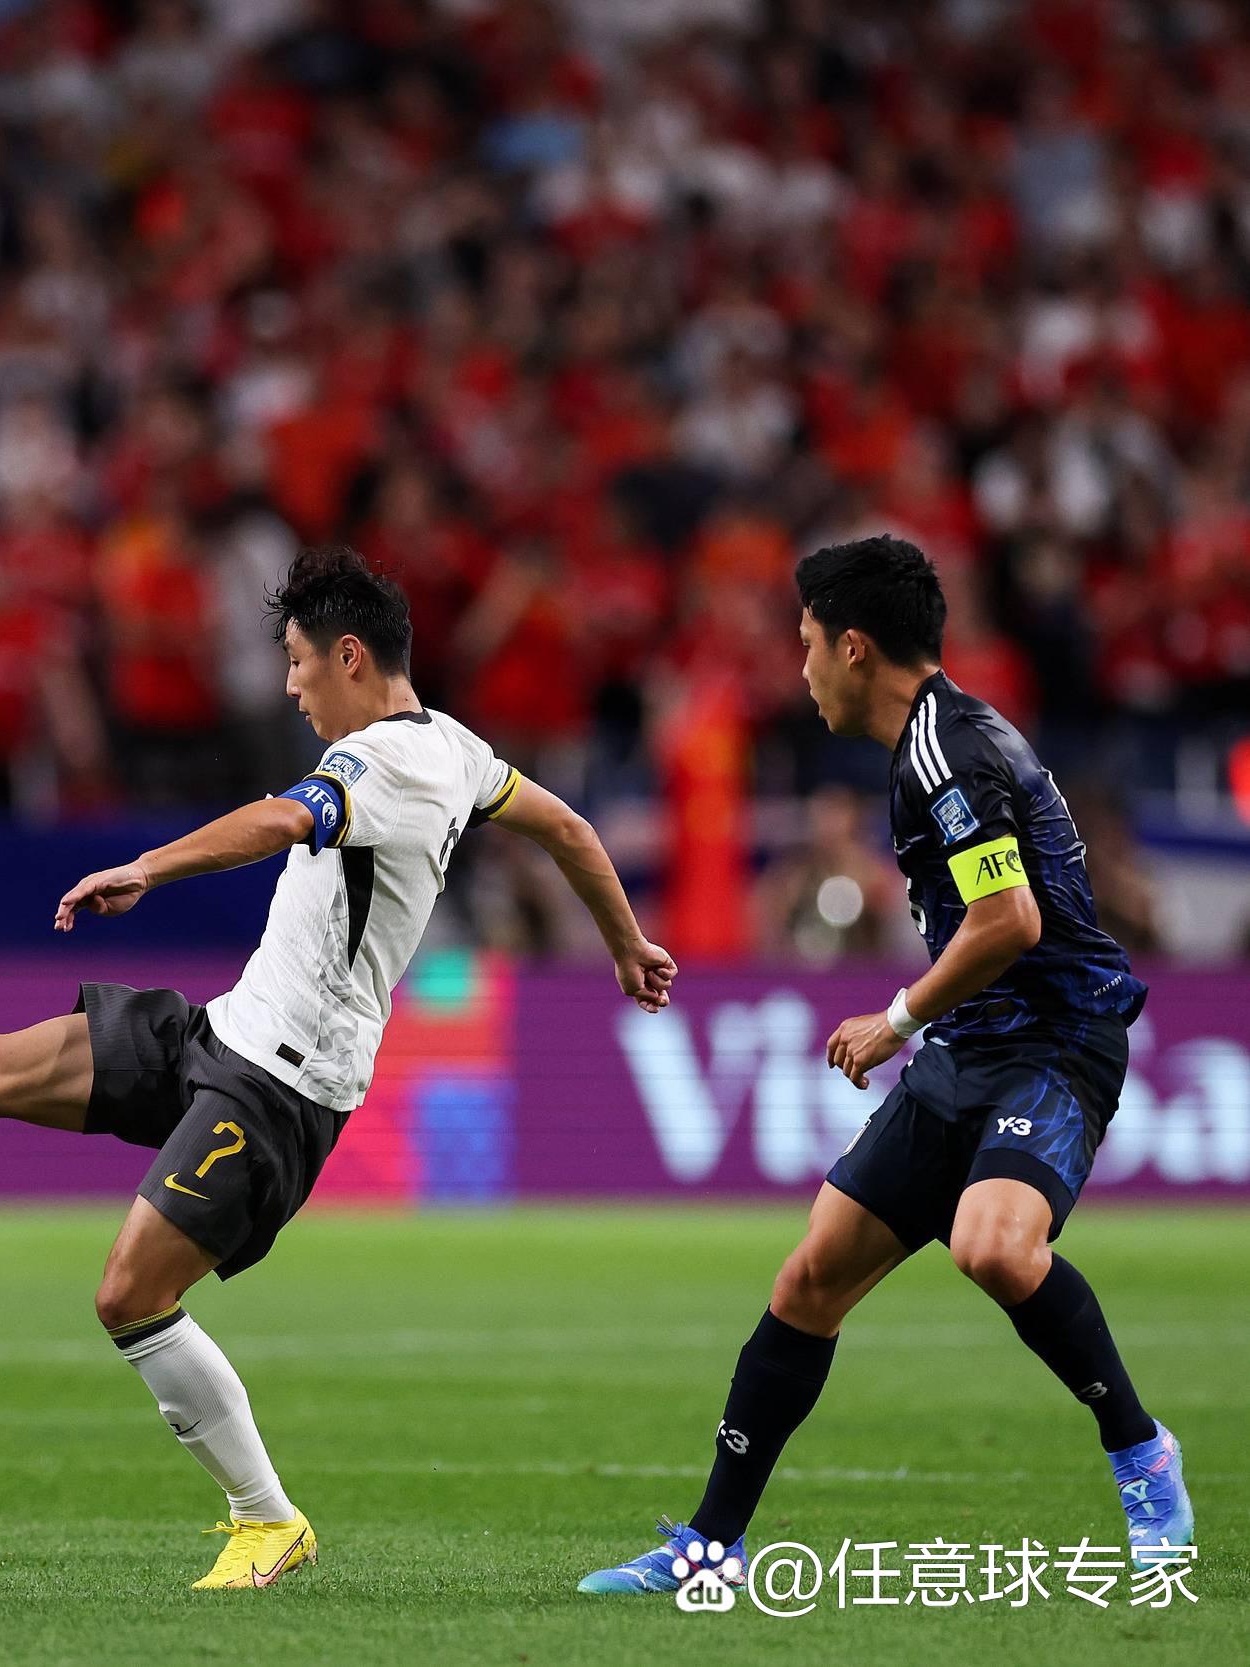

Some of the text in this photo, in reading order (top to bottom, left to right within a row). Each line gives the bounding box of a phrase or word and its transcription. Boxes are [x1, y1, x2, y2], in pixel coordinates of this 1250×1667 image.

[290, 785, 337, 828] AFC
[976, 849, 1022, 886] AFC
[997, 1116, 1033, 1136] Y-3
[194, 1121, 246, 1178] 7
